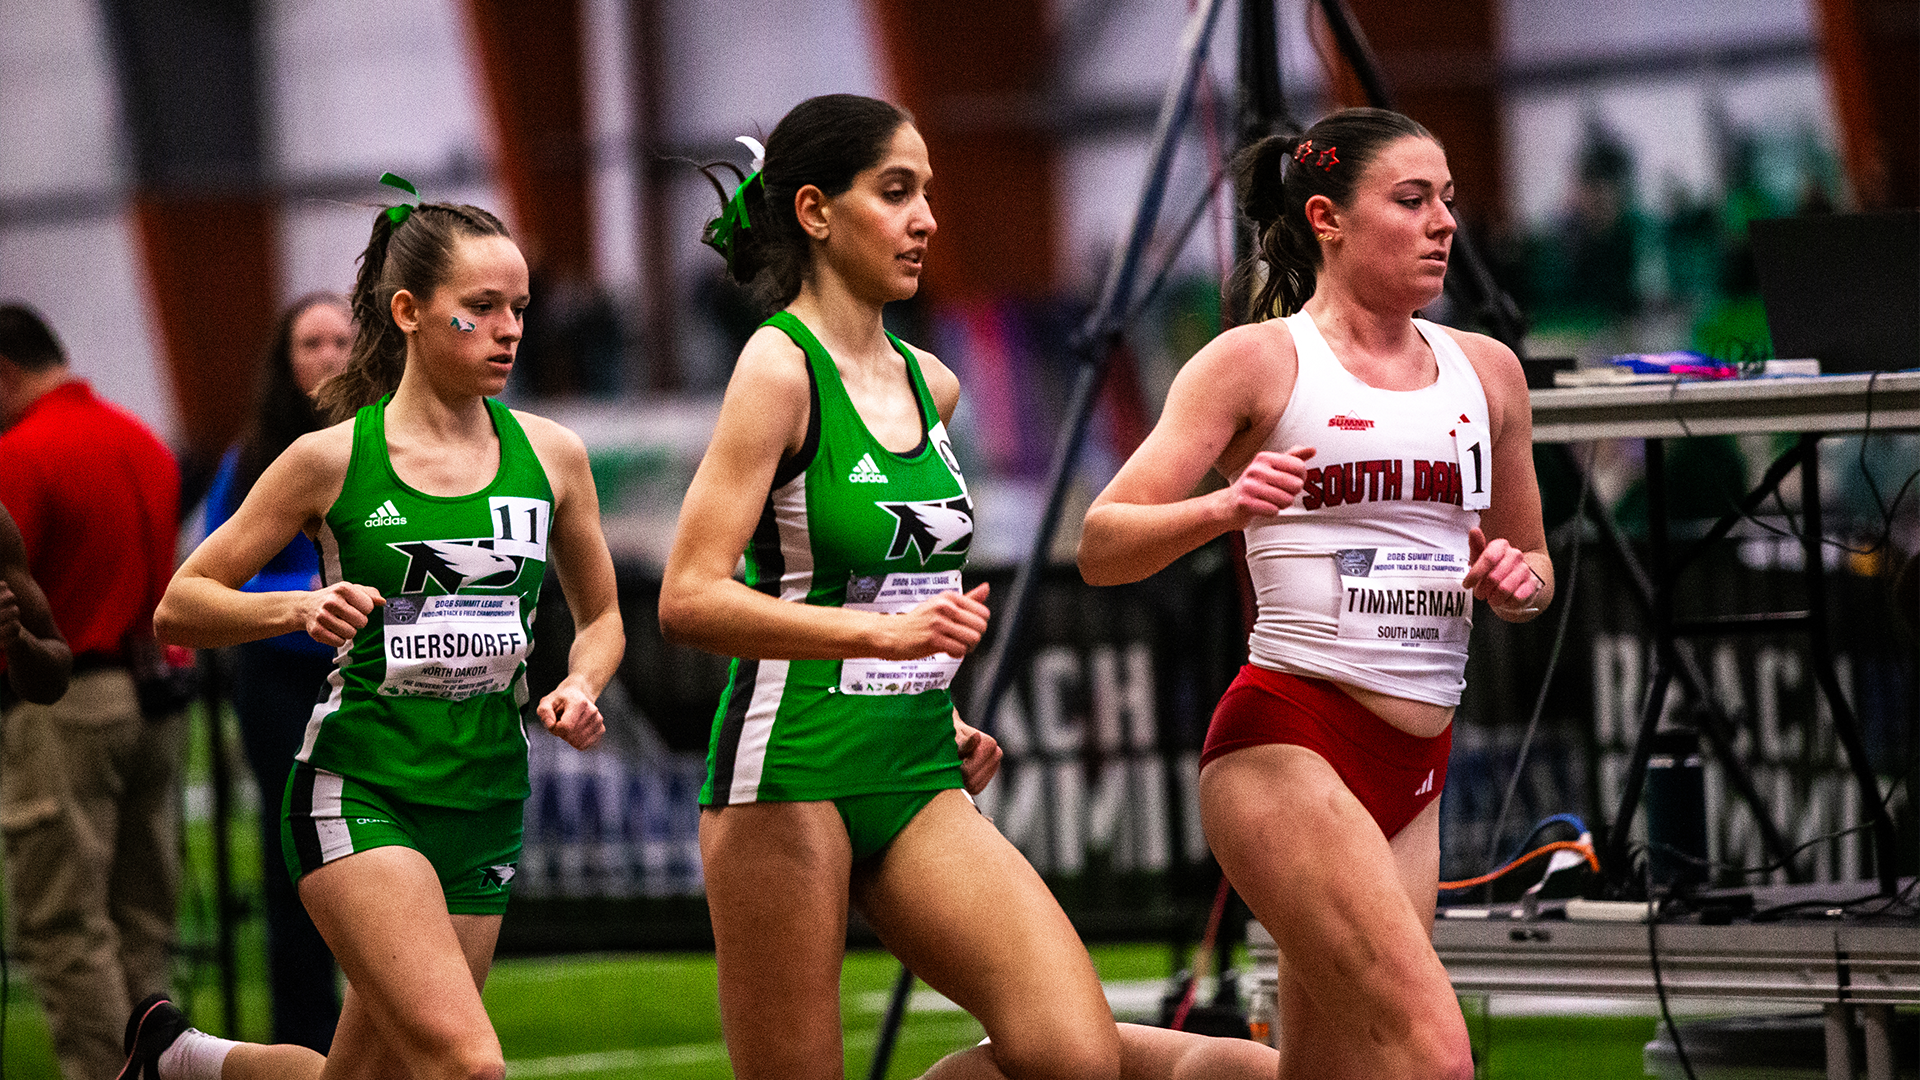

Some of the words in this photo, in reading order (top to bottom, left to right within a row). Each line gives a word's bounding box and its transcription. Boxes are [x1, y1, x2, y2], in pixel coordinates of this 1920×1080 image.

[1328, 418, 1374, 428] SUMMIT
[1467, 441, 1484, 494] 1
[849, 473, 888, 483] adidas
[1302, 459, 1402, 511] SOUTH
[1412, 459, 1463, 506] DAK
[364, 516, 408, 528] adidas
[493, 504, 540, 545] 11
[1387, 553, 1405, 561] 2026
[1407, 553, 1433, 561] SUMMIT
[1434, 554, 1455, 562] LEAGUE
[910, 577, 931, 585] SUMMIT
[932, 576, 949, 585] LEAGUE
[435, 600, 454, 608] 2026
[455, 600, 481, 608] SUMMIT
[481, 600, 503, 608] LEAGUE
[1348, 587, 1465, 617] TIMMERMAN
[422, 610, 444, 618] INDOOR
[1378, 626, 1408, 639] SOUTH
[1410, 627, 1439, 640] DAKOTA
[390, 632, 521, 659] GIERSDORFF
[421, 666, 452, 678] NORTH
[454, 666, 488, 677] DAKOTA
[415, 681, 451, 690] UNIVERSITY
